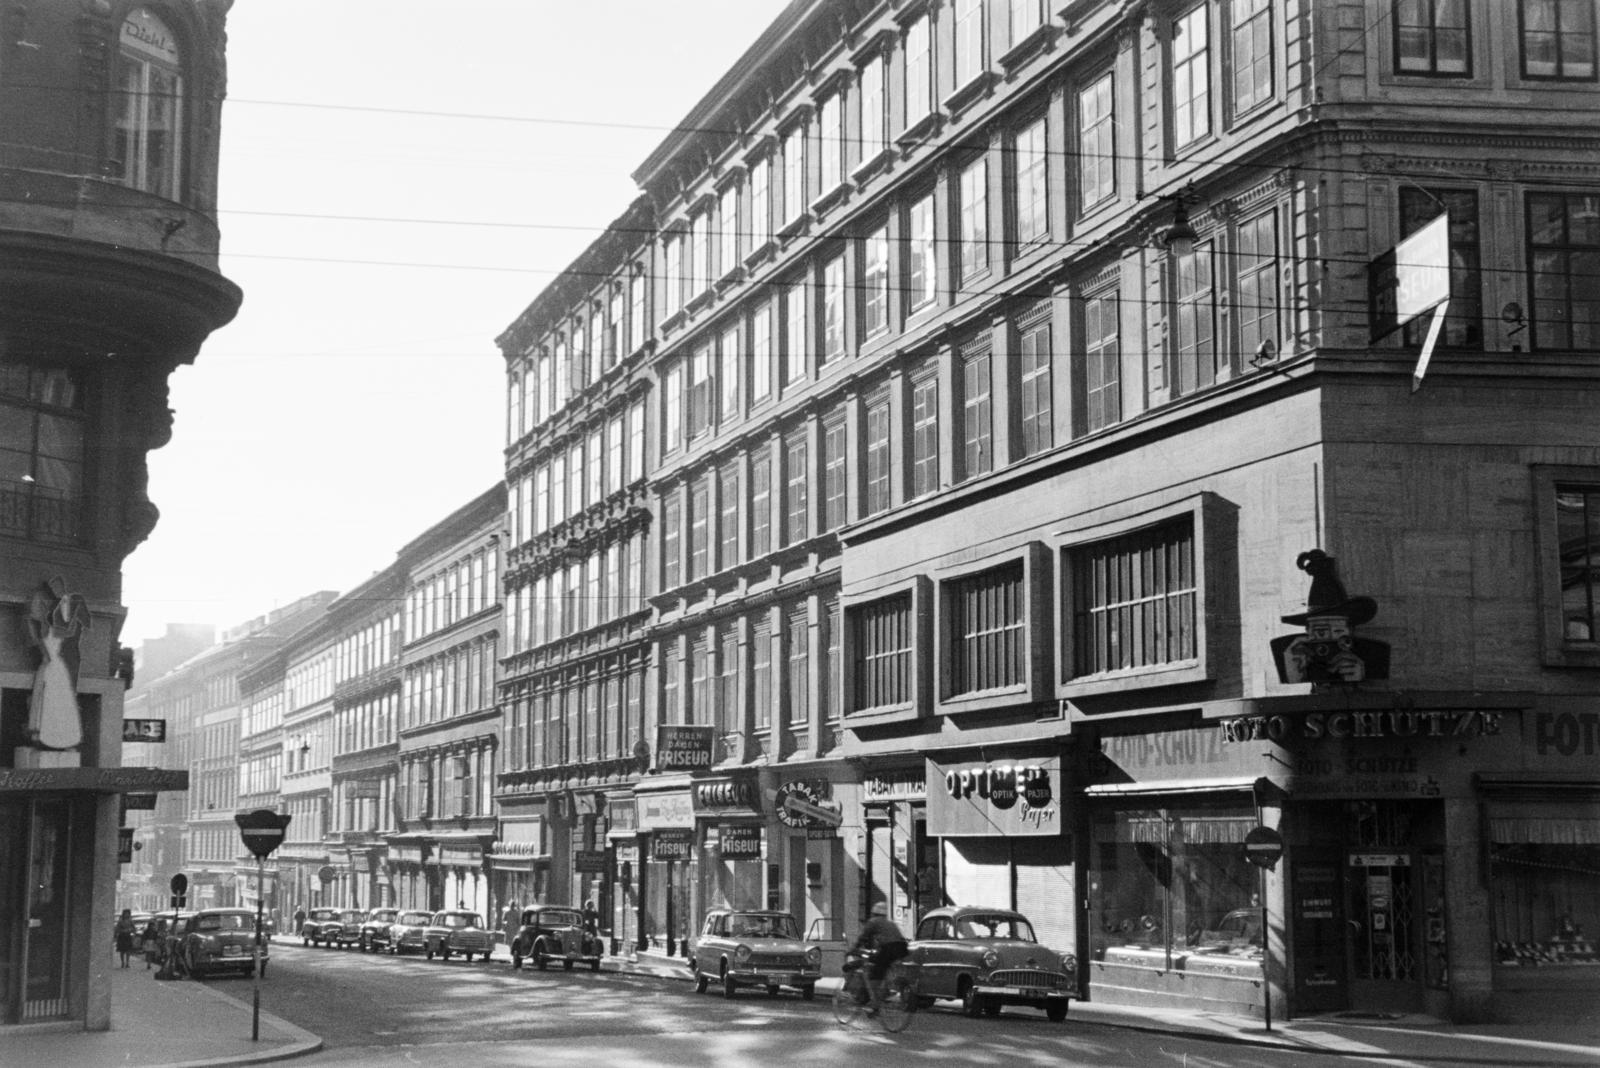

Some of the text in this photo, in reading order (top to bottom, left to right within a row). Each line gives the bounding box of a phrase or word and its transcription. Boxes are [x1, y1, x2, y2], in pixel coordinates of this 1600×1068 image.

[1220, 715, 1285, 744] FOTO
[1536, 712, 1600, 756] FOT
[658, 750, 710, 766] FRISEUR
[782, 783, 818, 803] TABAK
[992, 789, 1014, 799] OPTIK
[776, 806, 811, 828] TRAFIK
[654, 839, 691, 855] Friseur
[720, 836, 760, 853] Friseur
